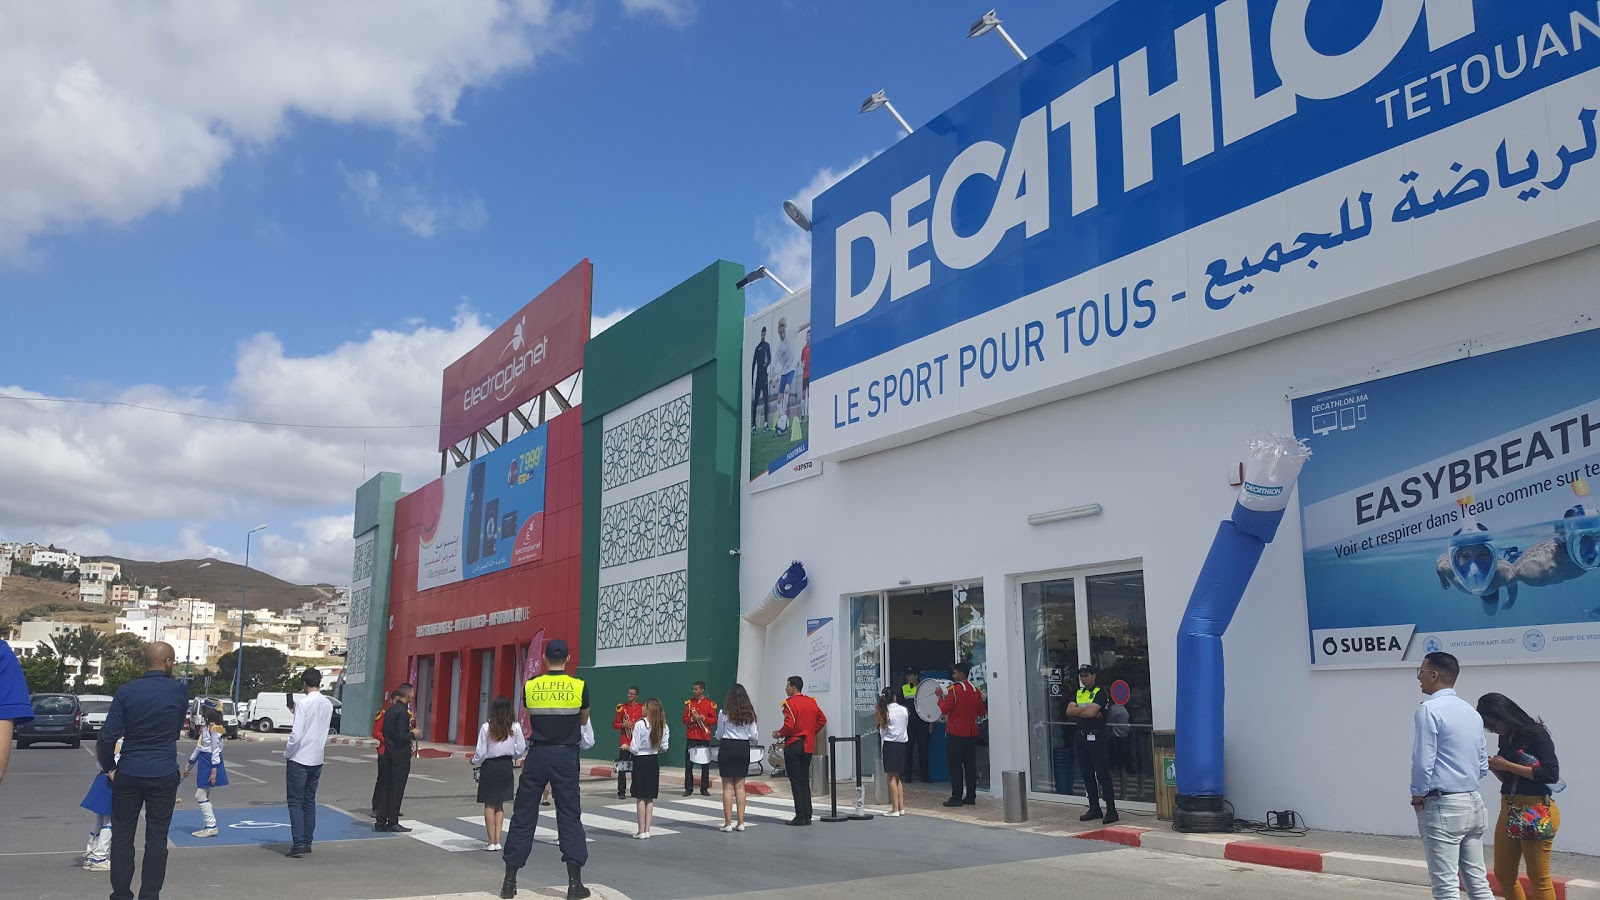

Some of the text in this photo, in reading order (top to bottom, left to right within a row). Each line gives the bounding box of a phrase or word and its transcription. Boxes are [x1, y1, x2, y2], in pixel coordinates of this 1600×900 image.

[1204, 190, 1373, 311] للجميع
[834, 386, 860, 429] LE
[867, 353, 949, 418] SPORT
[959, 320, 1045, 388] POUR
[1056, 279, 1156, 354] TOUS
[463, 335, 549, 411] Electroplanet
[1311, 393, 1369, 413] DECATHLON.MA
[786, 444, 805, 460] FOOTBALL
[1245, 483, 1281, 495] DECATHLON
[1334, 541, 1358, 559] Voir
[1361, 534, 1373, 550] et
[1376, 522, 1423, 546] respirer
[1426, 510, 1458, 530] dans
[1461, 498, 1493, 519] l'eau
[1497, 478, 1552, 506] comme
[1557, 468, 1582, 487] sur
[1341, 636, 1402, 653] SUBEA
[1449, 640, 1485, 648] VENTILATION
[532, 681, 574, 690] ALPHA
[531, 692, 575, 702] GUARD
